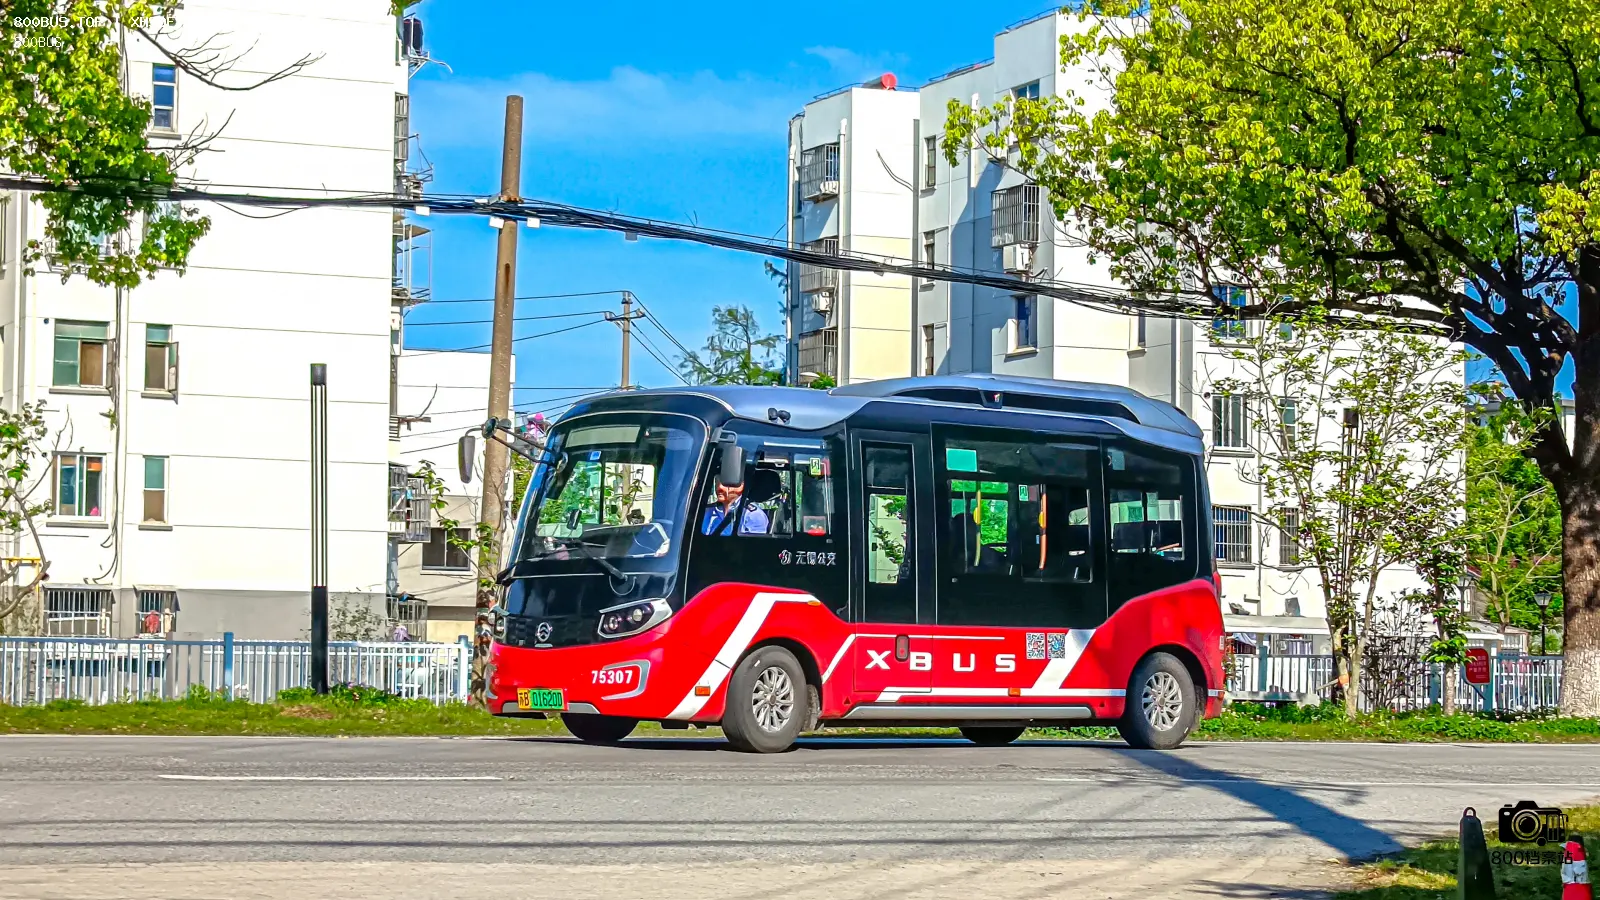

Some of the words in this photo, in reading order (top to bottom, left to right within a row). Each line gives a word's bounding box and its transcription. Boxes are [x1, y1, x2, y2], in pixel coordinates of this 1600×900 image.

[795, 550, 837, 566] 无锡公交
[591, 670, 633, 684] 75307
